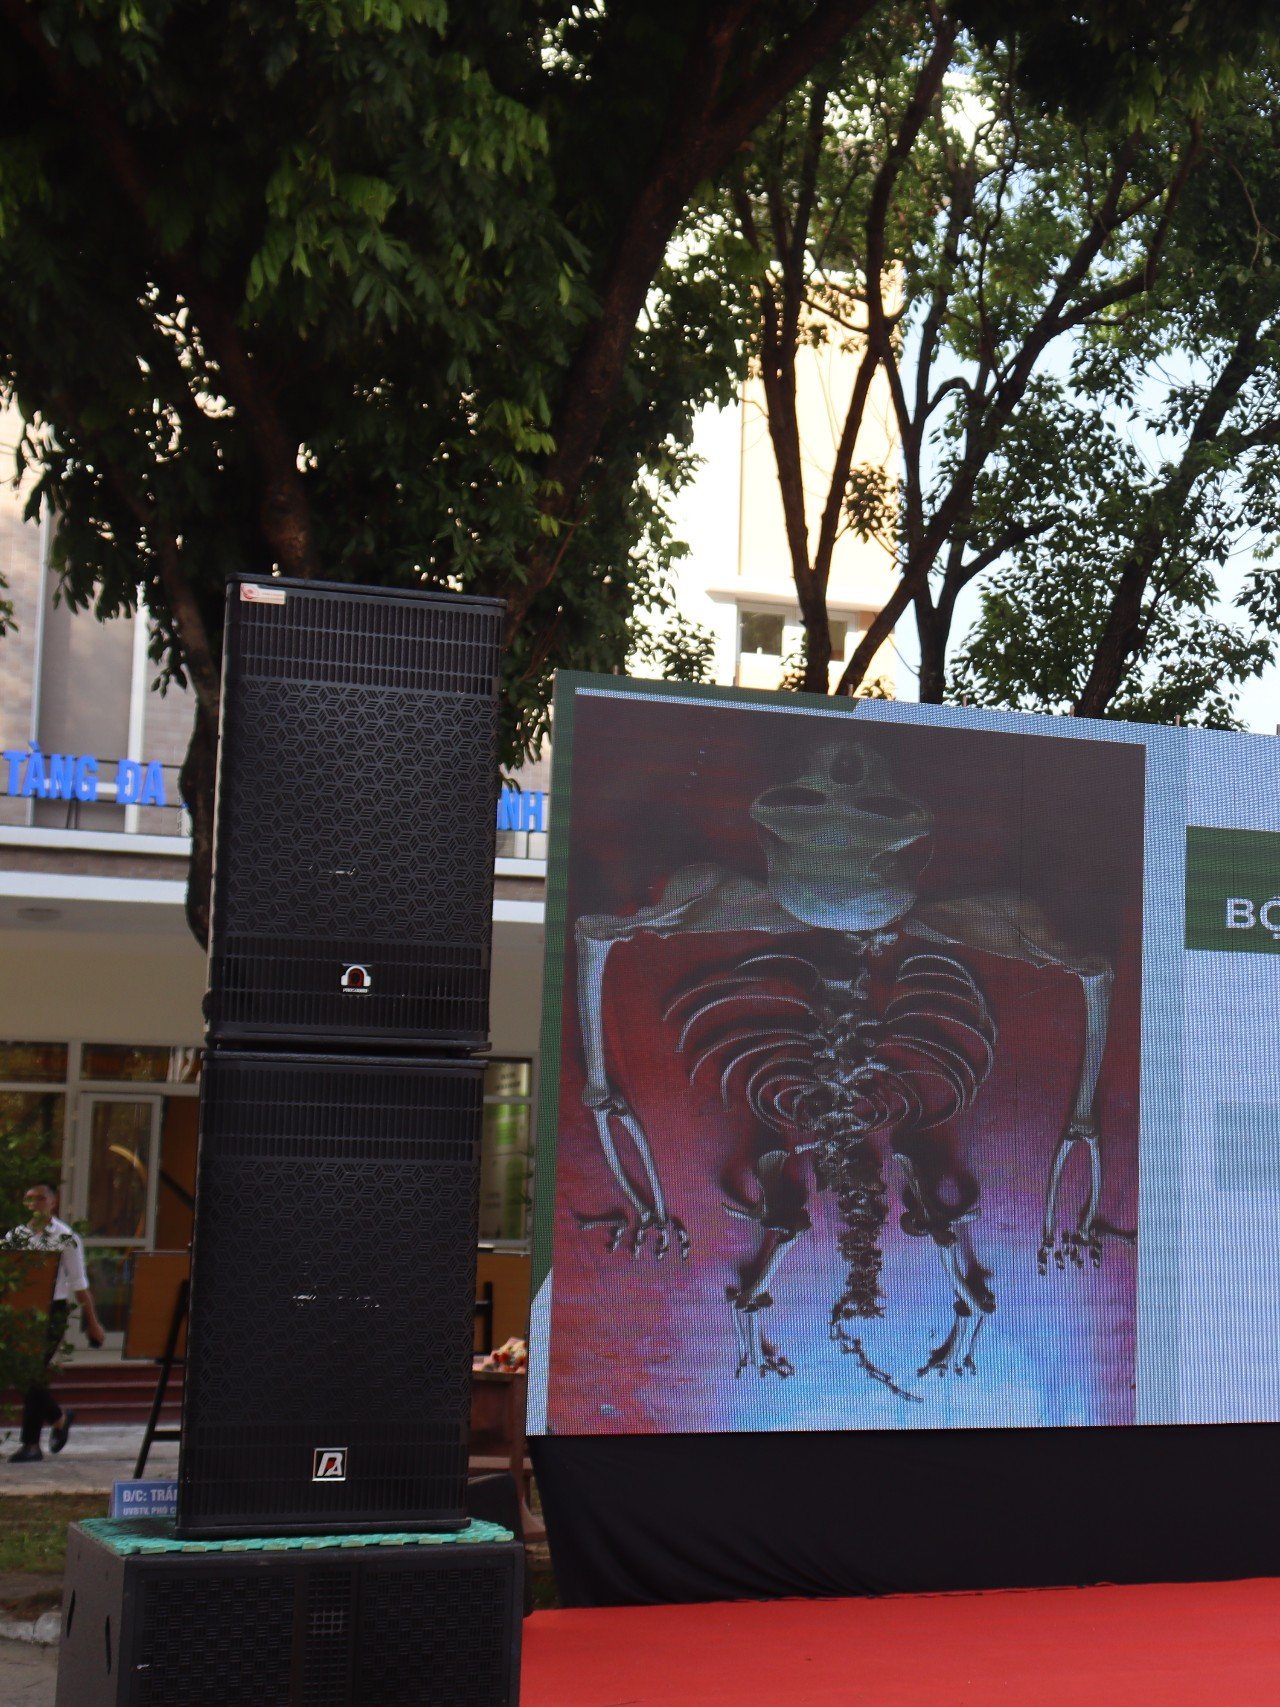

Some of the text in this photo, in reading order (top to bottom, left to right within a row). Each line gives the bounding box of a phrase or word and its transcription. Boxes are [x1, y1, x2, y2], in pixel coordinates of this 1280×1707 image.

[3, 740, 543, 832] TÀNG ĐA NH
